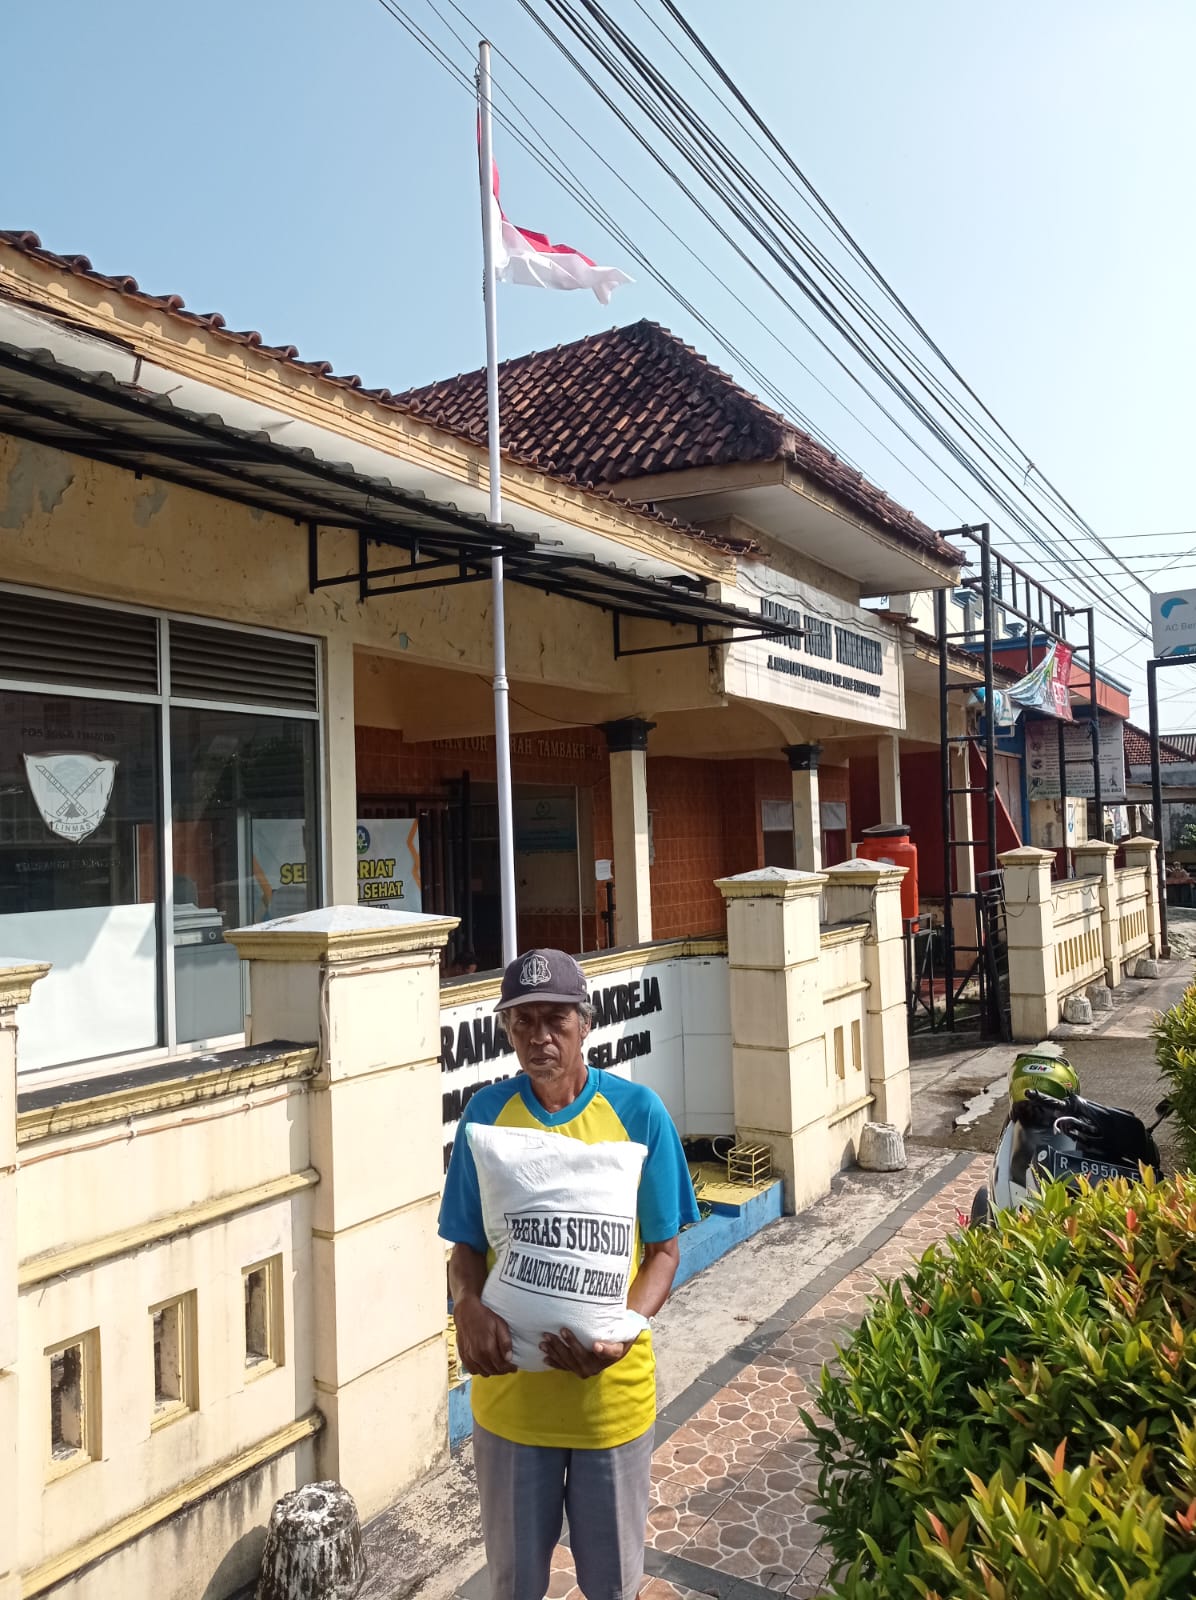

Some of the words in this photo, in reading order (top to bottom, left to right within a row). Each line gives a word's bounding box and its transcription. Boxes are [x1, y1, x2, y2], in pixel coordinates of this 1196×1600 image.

[803, 614, 833, 661] LURAH
[834, 625, 883, 676] TAMBAKREJA
[54, 822, 92, 832] LINMAS
[364, 881, 403, 899] SEHAT
[587, 1030, 652, 1069] SELATAN
[1060, 1156, 1069, 1169] R
[1080, 1161, 1119, 1179] 6950
[511, 1216, 562, 1249] BERAS
[566, 1216, 631, 1257] SUBSIDI
[504, 1251, 520, 1278] PT.
[517, 1255, 581, 1293] MANUNGGAL
